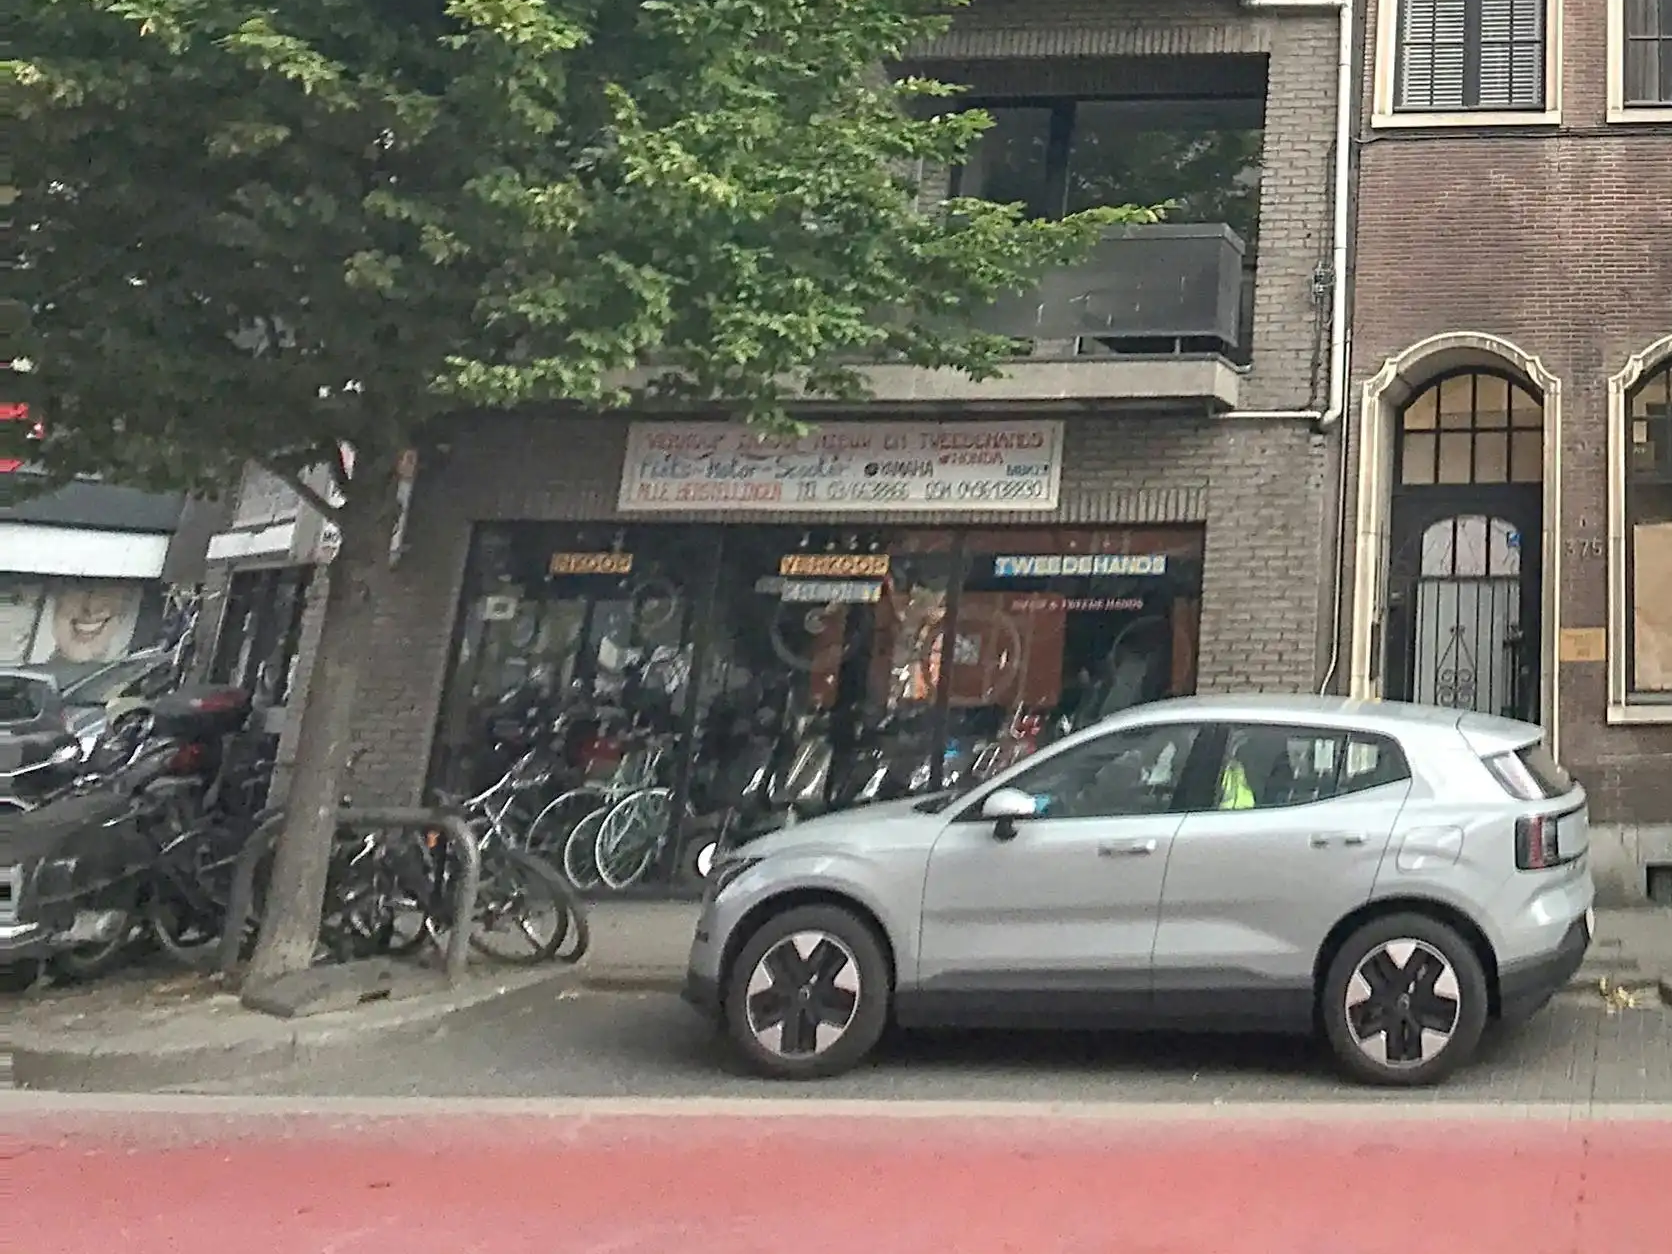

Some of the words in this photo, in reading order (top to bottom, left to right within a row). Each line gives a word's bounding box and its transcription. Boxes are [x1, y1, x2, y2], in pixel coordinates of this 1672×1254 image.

[880, 458, 935, 479] YAMAHA
[1564, 537, 1602, 557] 375
[994, 554, 1168, 577] TWEEDEHANDS
